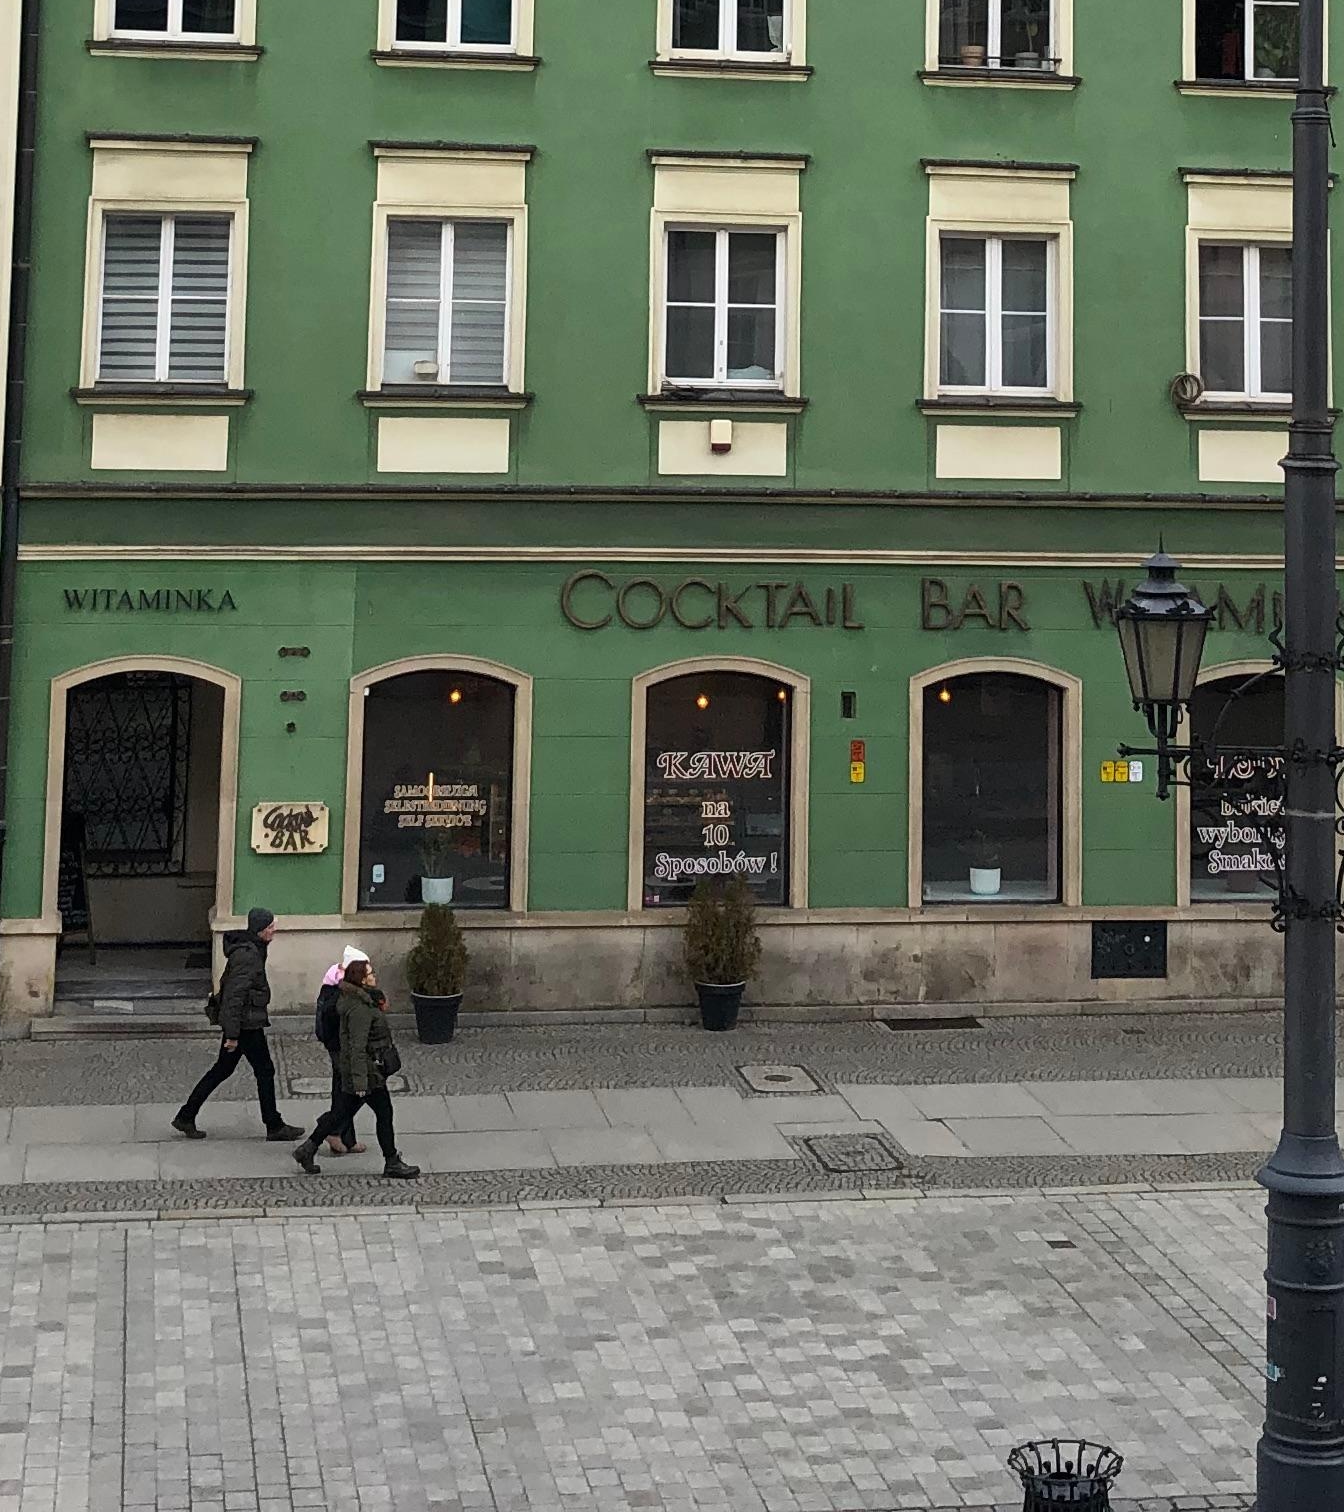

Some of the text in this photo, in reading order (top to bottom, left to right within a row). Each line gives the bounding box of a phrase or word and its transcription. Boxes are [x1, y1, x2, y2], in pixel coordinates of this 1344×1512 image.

[63, 588, 239, 612] WITAMINKA
[561, 568, 865, 631] COCKTAIL
[920, 576, 1031, 631] BAR
[656, 749, 776, 779] KAWA
[397, 814, 473, 828] SELF SERVICE
[701, 801, 731, 818] na
[269, 829, 316, 851] BAR
[702, 824, 730, 846] 10
[654, 850, 778, 881] Sposobów !
